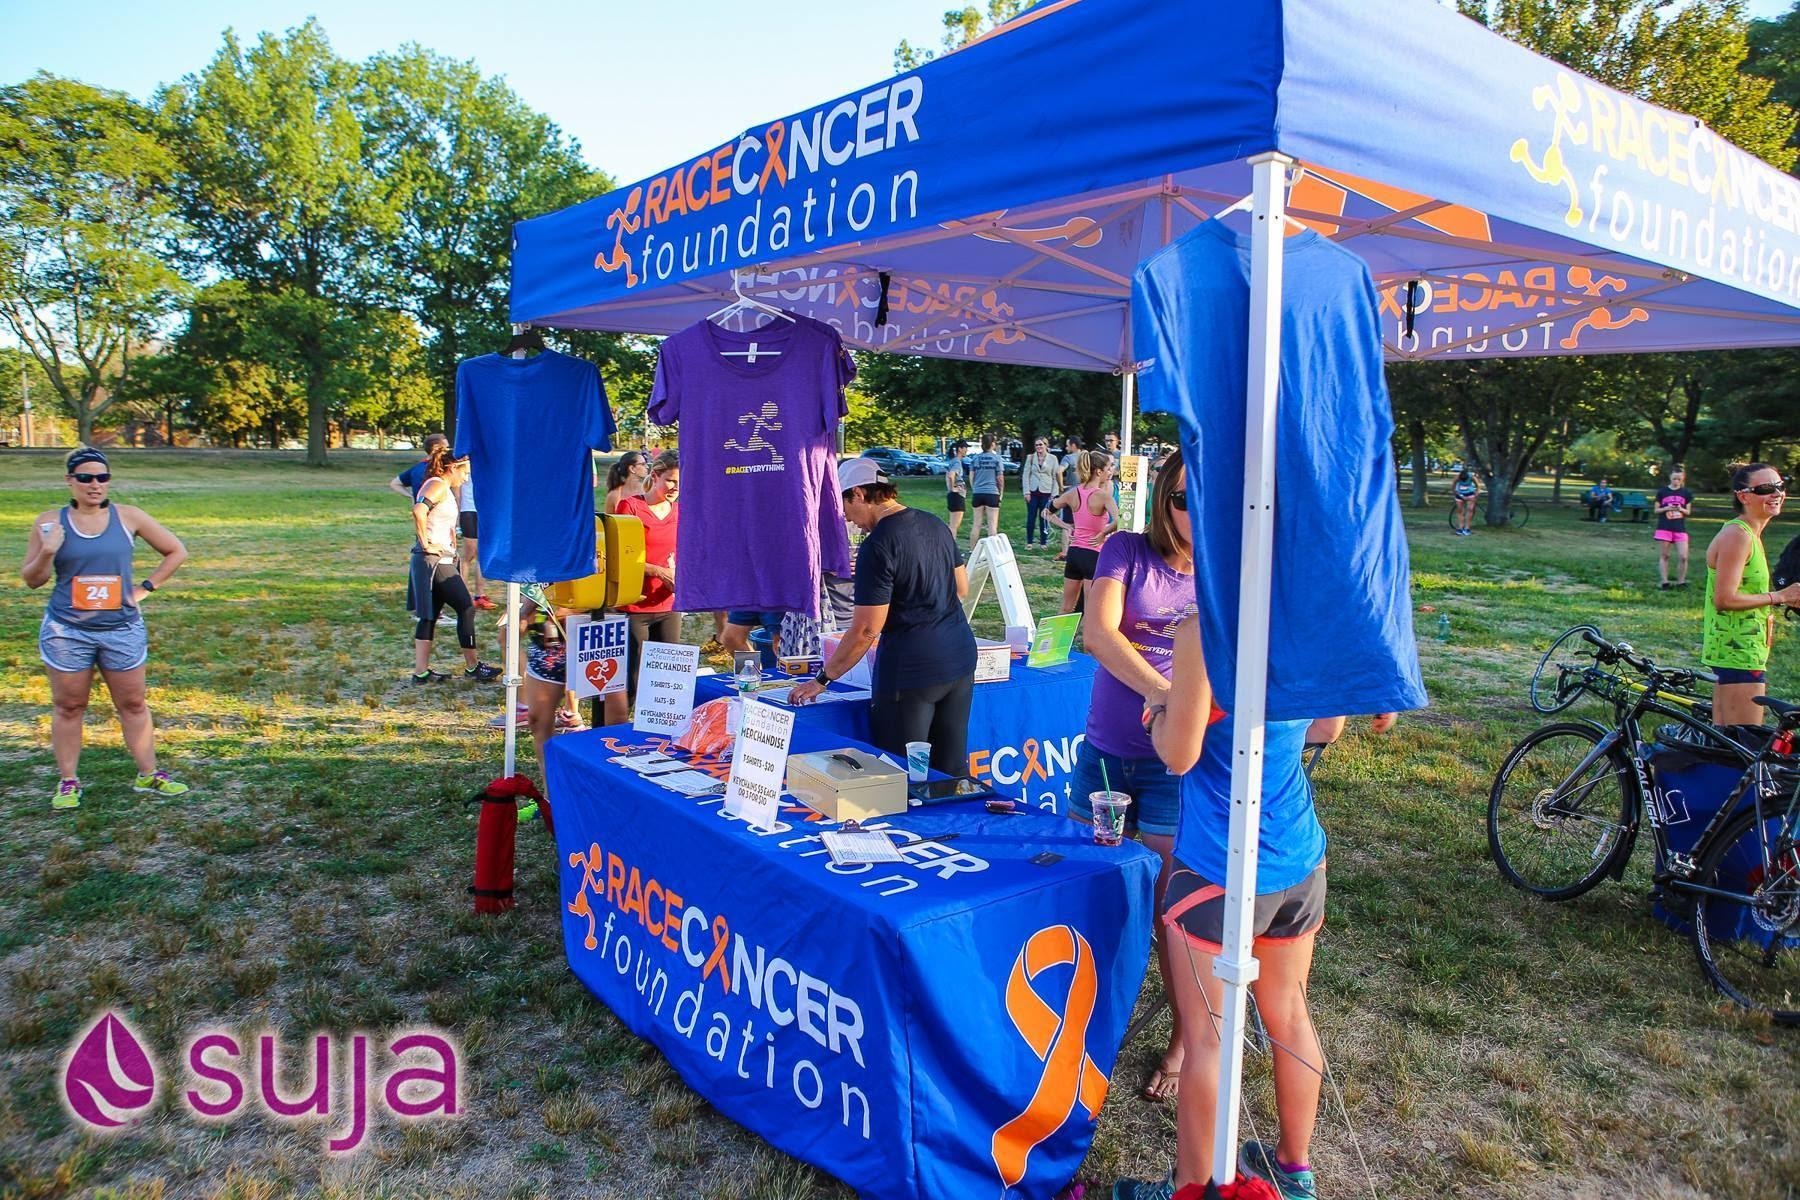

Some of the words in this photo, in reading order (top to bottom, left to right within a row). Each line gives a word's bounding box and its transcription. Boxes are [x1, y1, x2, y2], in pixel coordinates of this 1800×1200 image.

[641, 169, 919, 284] foundation
[86, 586, 109, 600] 24
[578, 621, 626, 652] FREE
[578, 646, 625, 663] SUNSCREEN
[653, 654, 694, 664] foundation
[646, 661, 692, 673] MERCHANDISE
[742, 713, 788, 737] foundation
[740, 727, 785, 750] MERCHANDISE
[764, 761, 775, 773] $20
[732, 775, 758, 793] KEYCHAINS
[757, 783, 764, 795] $5
[763, 786, 777, 799] EACH
[738, 787, 746, 797] OR
[745, 789, 750, 799] 3
[748, 791, 759, 803] FOR
[758, 795, 767, 806] $10
[1633, 756, 1661, 829] RALEIGH
[601, 911, 871, 1139] foundation
